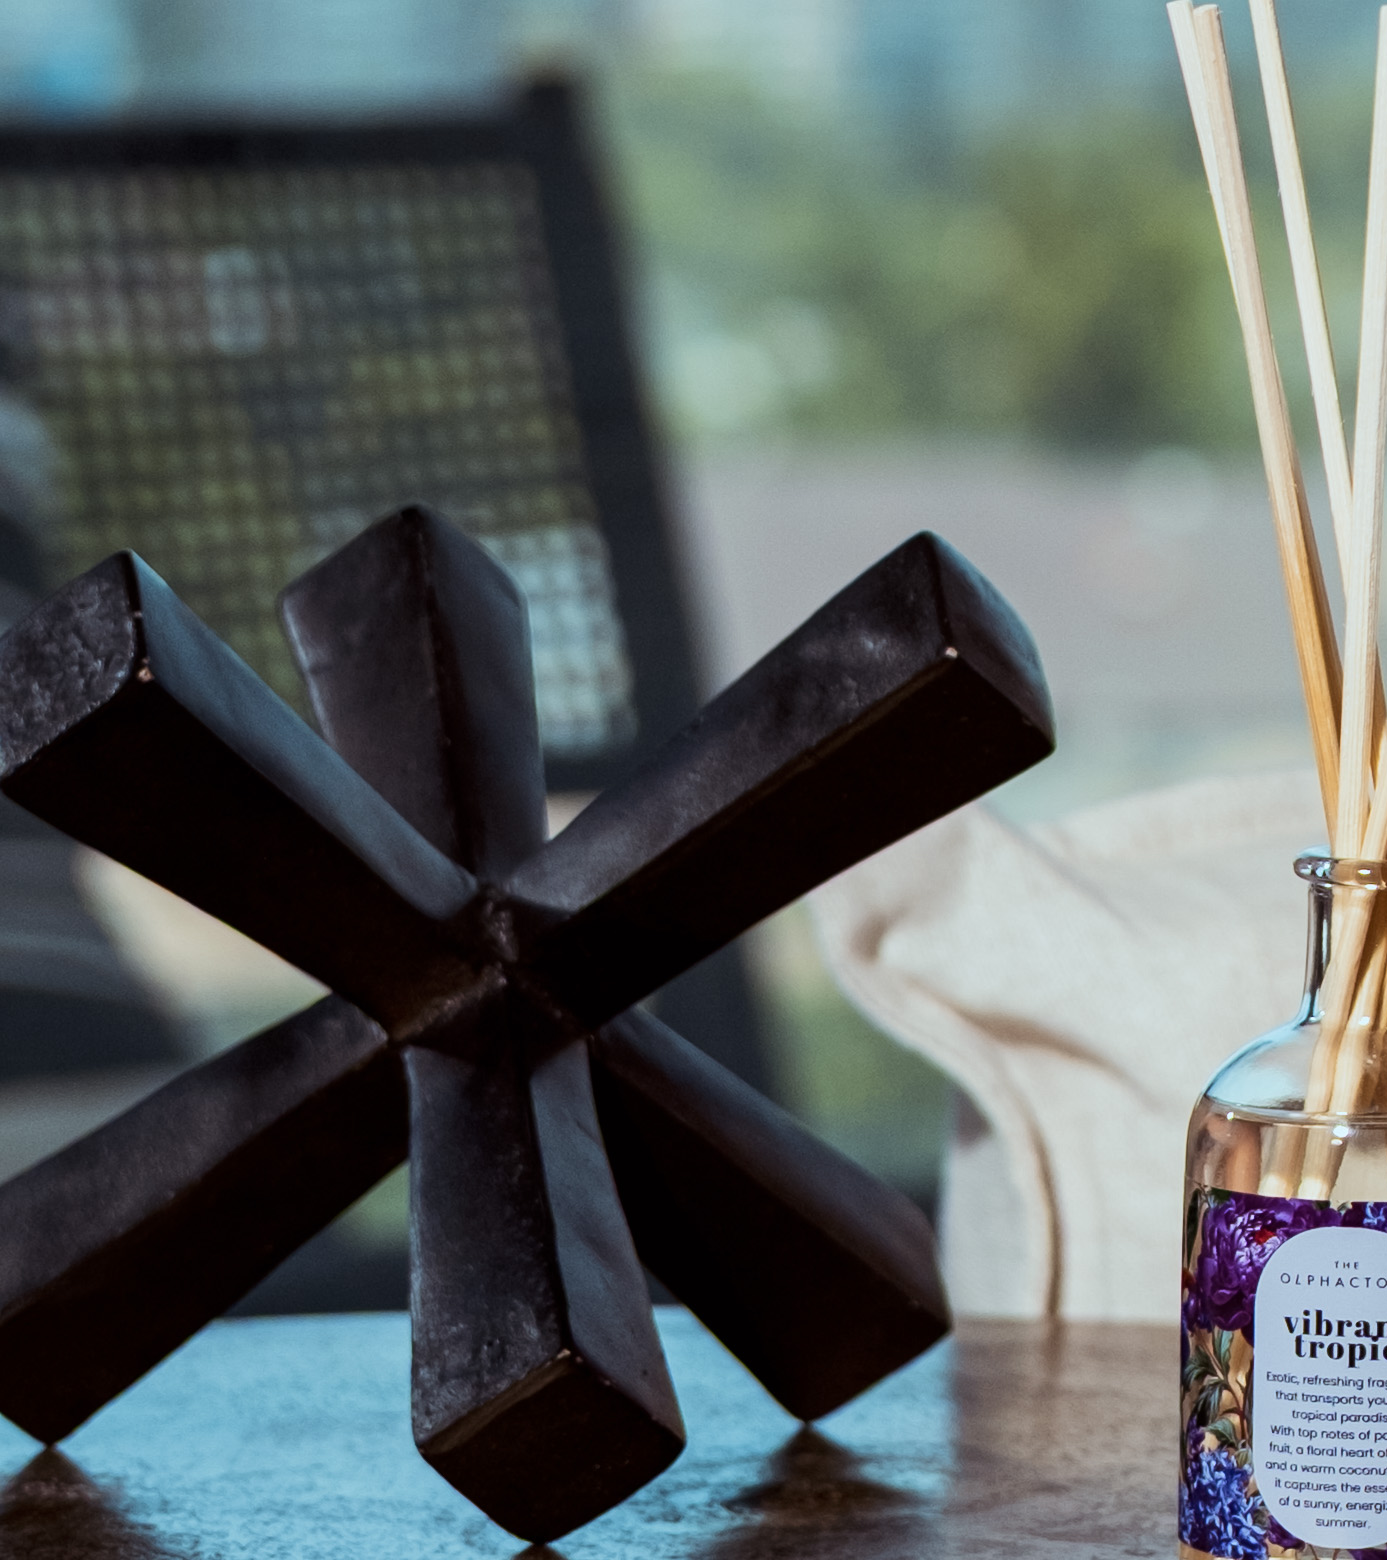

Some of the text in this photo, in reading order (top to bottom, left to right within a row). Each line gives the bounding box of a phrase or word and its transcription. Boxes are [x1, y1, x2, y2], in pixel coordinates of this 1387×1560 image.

[1334, 1261, 1359, 1270] THE
[1266, 1371, 1299, 1385] Exotic,
[1303, 1374, 1363, 1390] refreshing
[1275, 1391, 1297, 1400] that
[1302, 1393, 1363, 1406] transports
[1292, 1410, 1337, 1422] tropical
[1271, 1425, 1295, 1437] With
[1298, 1428, 1317, 1440] top
[1321, 1430, 1354, 1440] notes
[1358, 1430, 1370, 1440] of
[1269, 1443, 1292, 1456] fruit,
[1296, 1447, 1304, 1455] a
[1307, 1447, 1337, 1457] floral
[1341, 1447, 1373, 1457] heart
[1265, 1461, 1287, 1471] and
[1290, 1463, 1297, 1471] a
[1301, 1464, 1335, 1474] warm
[1275, 1477, 1281, 1488] it
[1284, 1480, 1337, 1492] captures
[1341, 1481, 1360, 1492] the
[1279, 1496, 1289, 1506] of
[1293, 1499, 1300, 1507] a
[1304, 1500, 1342, 1512] sunny,
[1316, 1518, 1371, 1528] summer.
